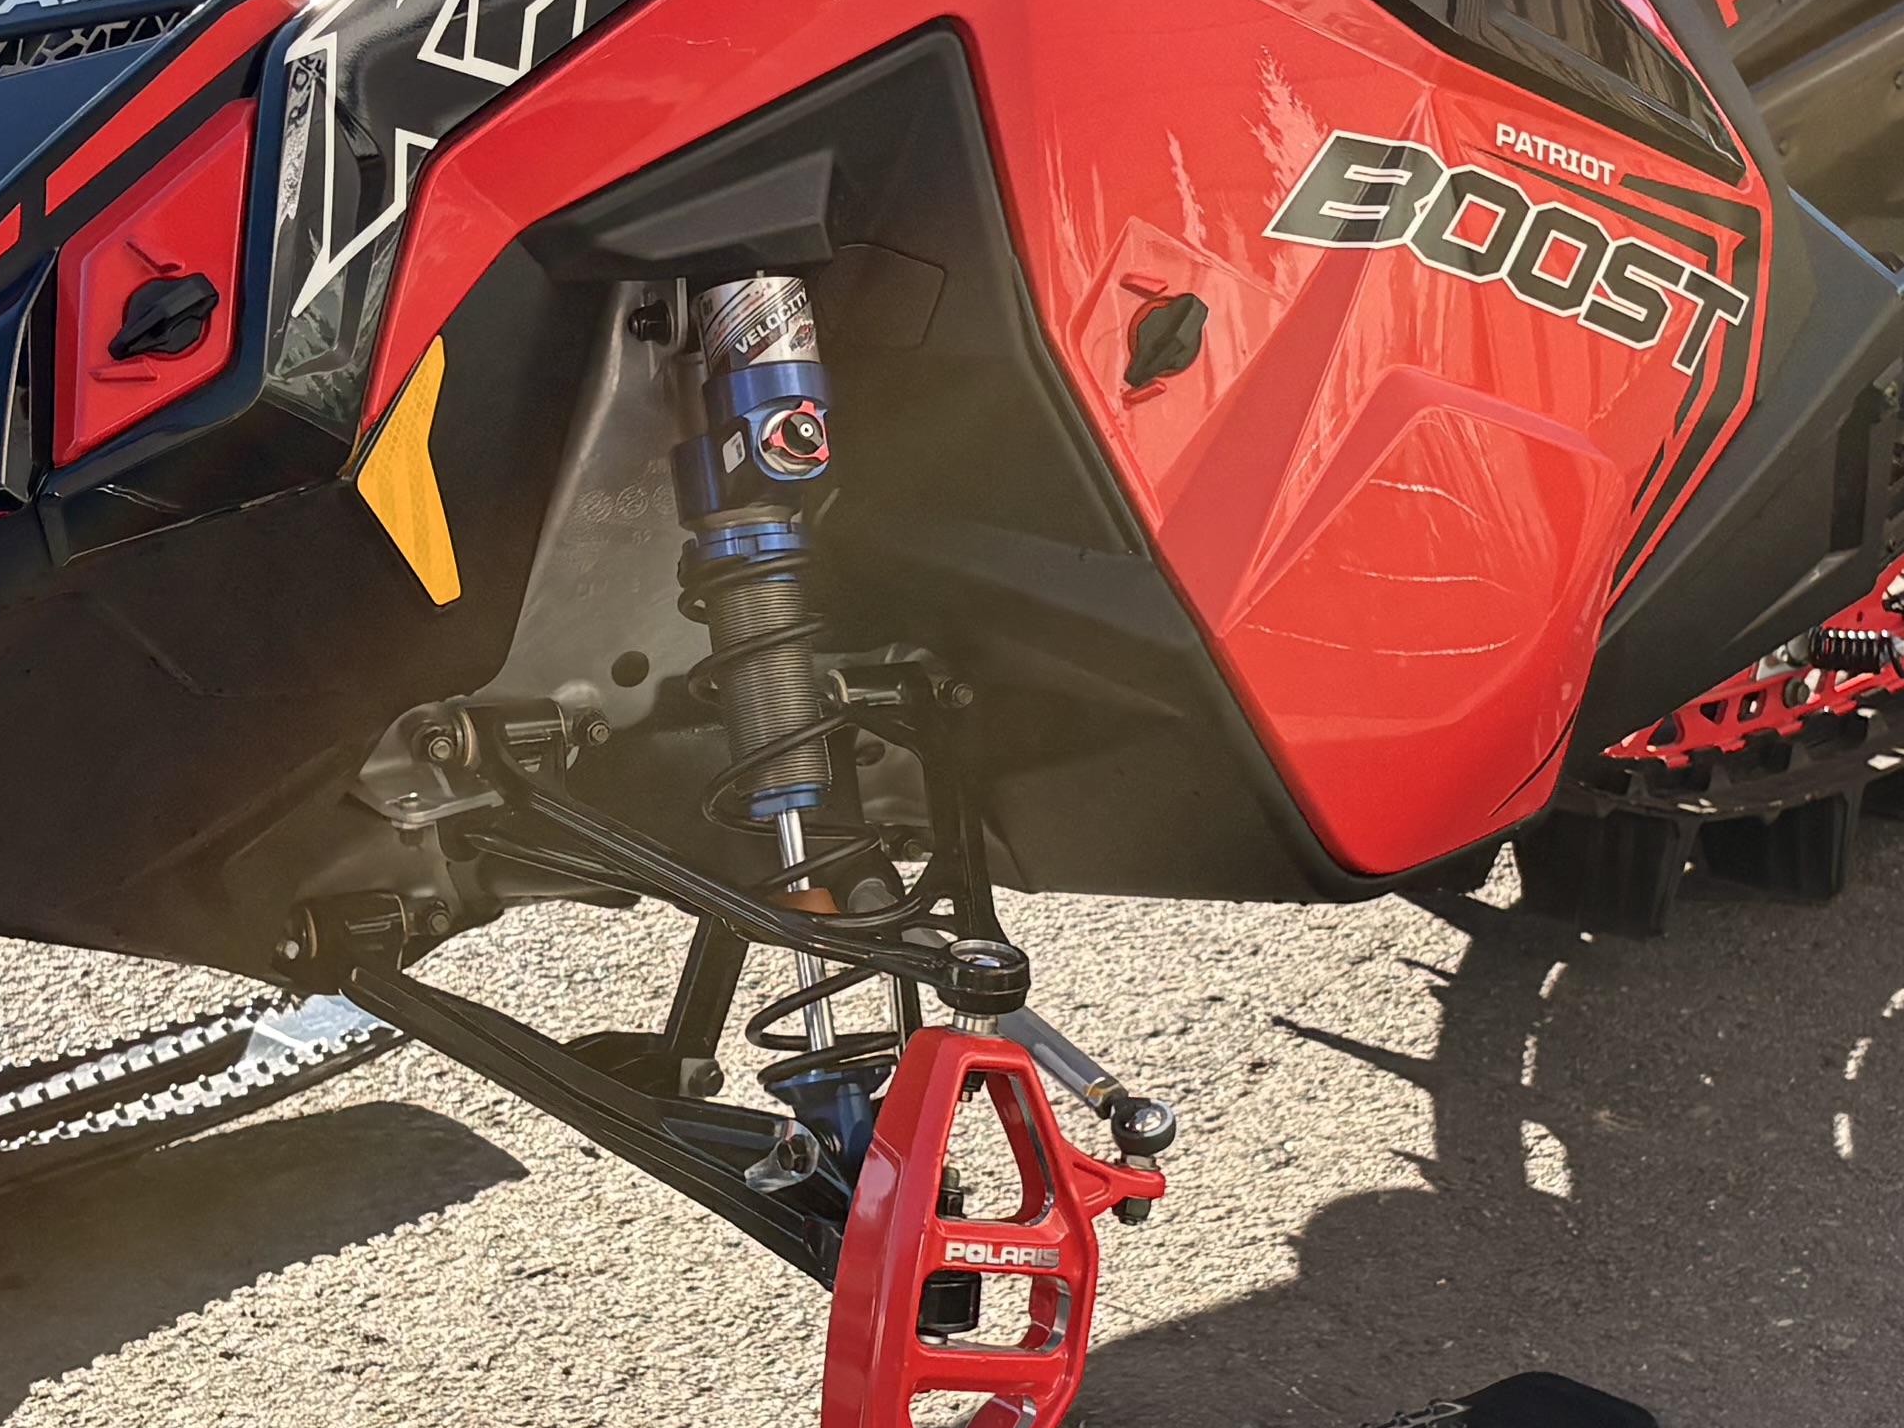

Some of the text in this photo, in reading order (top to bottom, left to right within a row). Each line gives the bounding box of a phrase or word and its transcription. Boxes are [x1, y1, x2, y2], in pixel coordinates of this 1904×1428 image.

[1496, 122, 1616, 186] PATRIOT
[1262, 129, 1749, 376] BOOST
[734, 288, 808, 354] VELOCITY
[944, 1241, 1060, 1268] POLARIS
